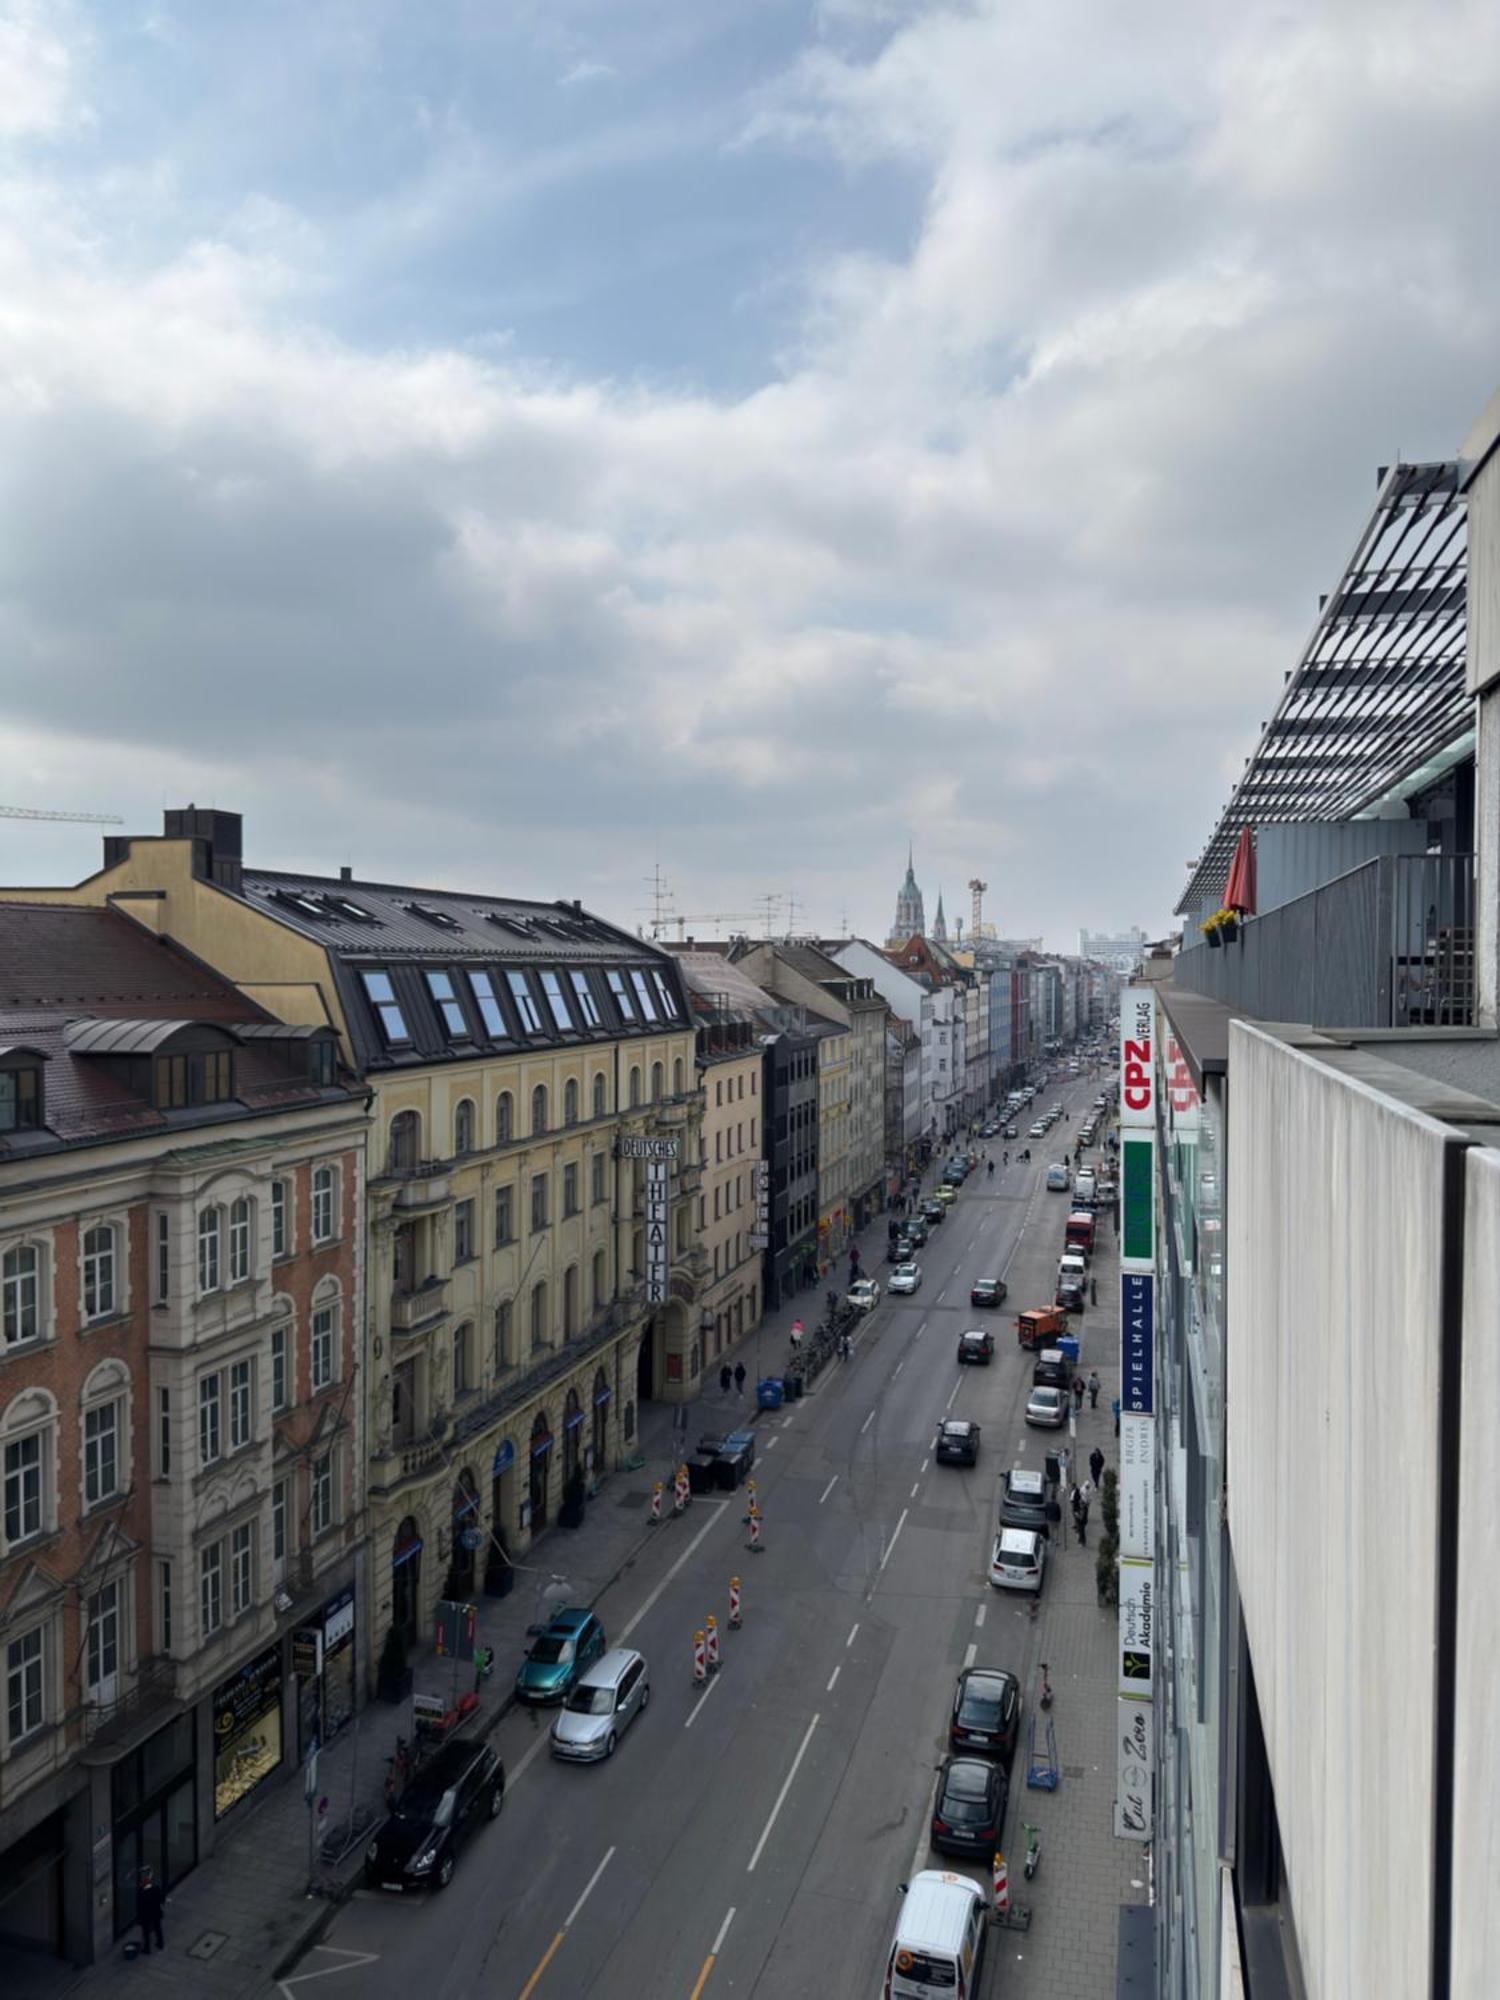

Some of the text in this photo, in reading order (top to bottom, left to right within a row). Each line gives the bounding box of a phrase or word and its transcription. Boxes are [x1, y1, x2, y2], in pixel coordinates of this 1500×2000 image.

[1124, 1002, 1151, 1110] CPZ VERLAG
[623, 1138, 677, 1158] DEUTSCHES
[649, 1162, 663, 1302] THEATER
[1131, 1277, 1143, 1410] SPIELHALLE
[1124, 1598, 1137, 1646] Deutsch
[1138, 1582, 1152, 1648] Akademie
[1122, 1712, 1147, 1761] Zero
